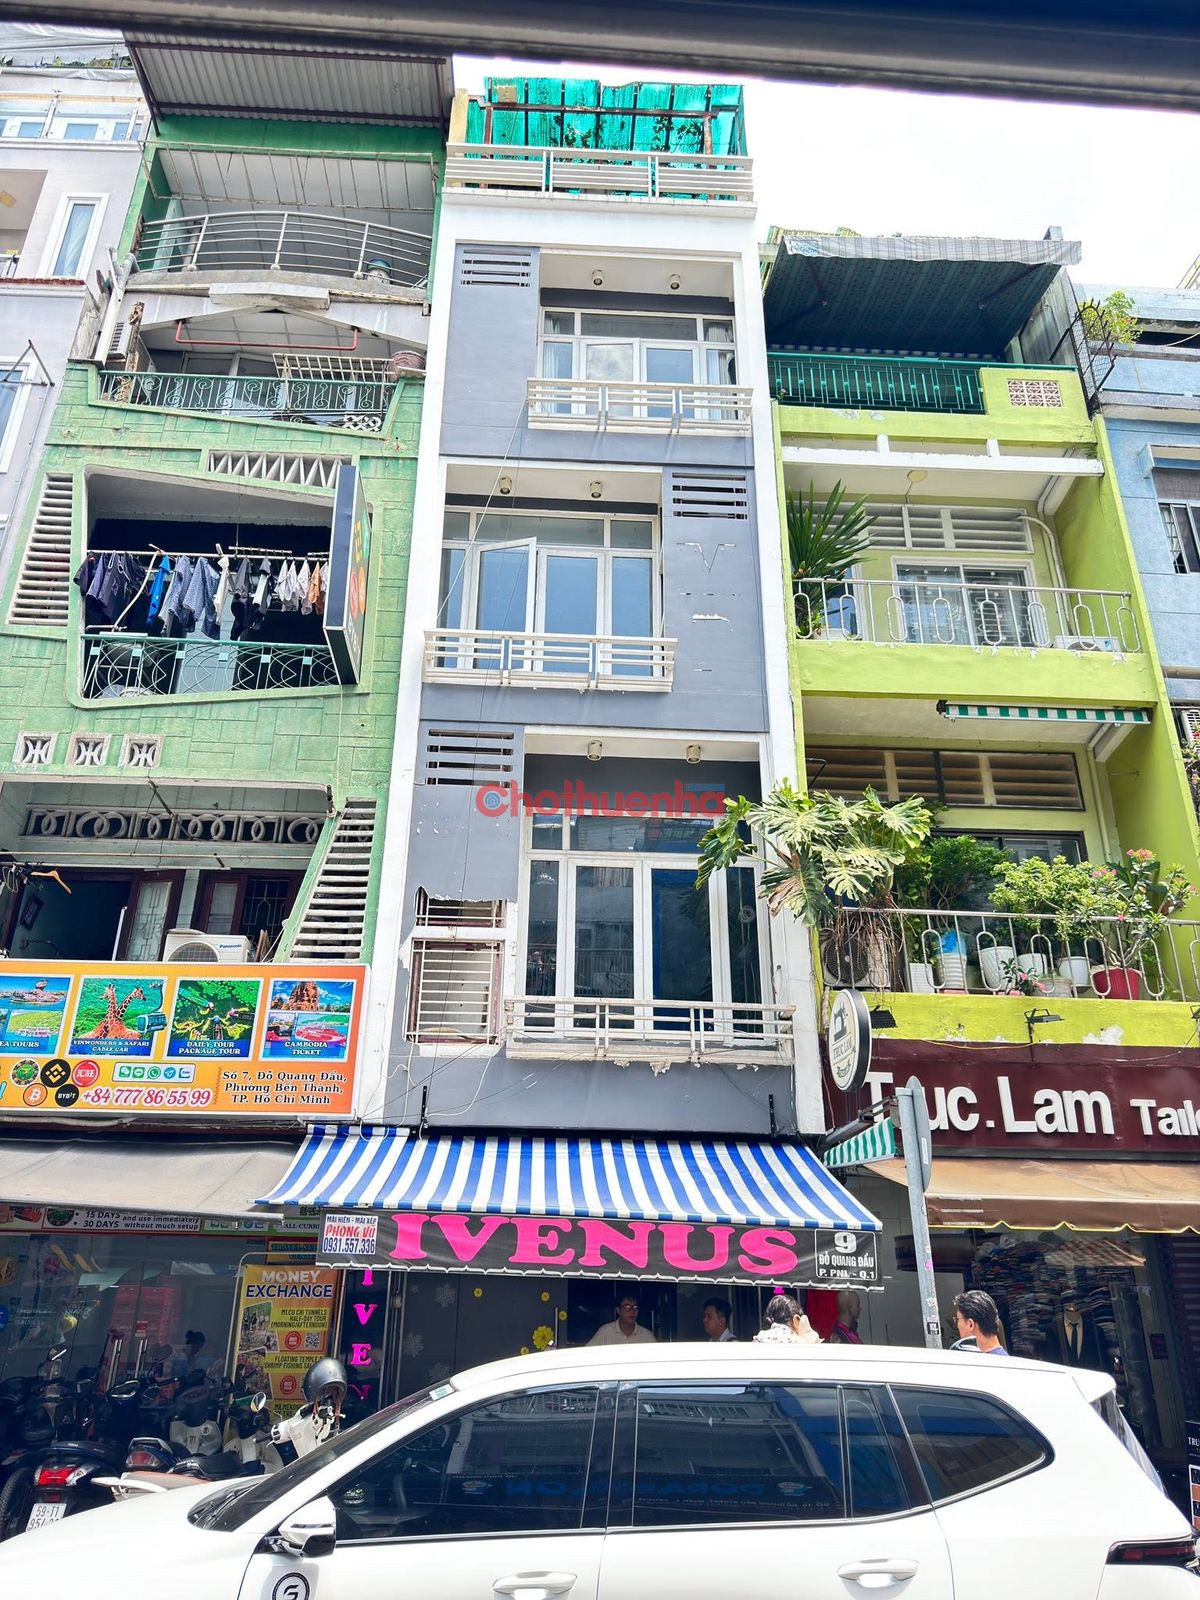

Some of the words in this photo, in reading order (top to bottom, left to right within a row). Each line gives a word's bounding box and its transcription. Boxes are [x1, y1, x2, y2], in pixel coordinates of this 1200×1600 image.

[223, 1070, 237, 1080] Số
[277, 1072, 316, 1082] Quang
[83, 1088, 110, 1103] +84
[115, 1088, 142, 1104] 777
[144, 1089, 165, 1105] 86
[167, 1090, 187, 1105] 55
[191, 1090, 211, 1105] 99
[232, 1094, 249, 1103] TP.
[300, 1095, 330, 1104] Minh
[98, 1211, 120, 1219] DAYS
[153, 1215, 199, 1223] immediately
[83, 1220, 94, 1228] 30
[96, 1220, 119, 1228] DAYS
[326, 1224, 360, 1237] PHONG
[323, 1237, 375, 1253] 0931.557.336
[388, 1213, 799, 1276] IVENUS
[834, 1232, 857, 1253] 9
[831, 1255, 857, 1267] QUANG
[262, 1270, 321, 1283] MONEY
[860, 1271, 875, 1280] Q.1
[246, 1284, 333, 1298] EXCHANGE
